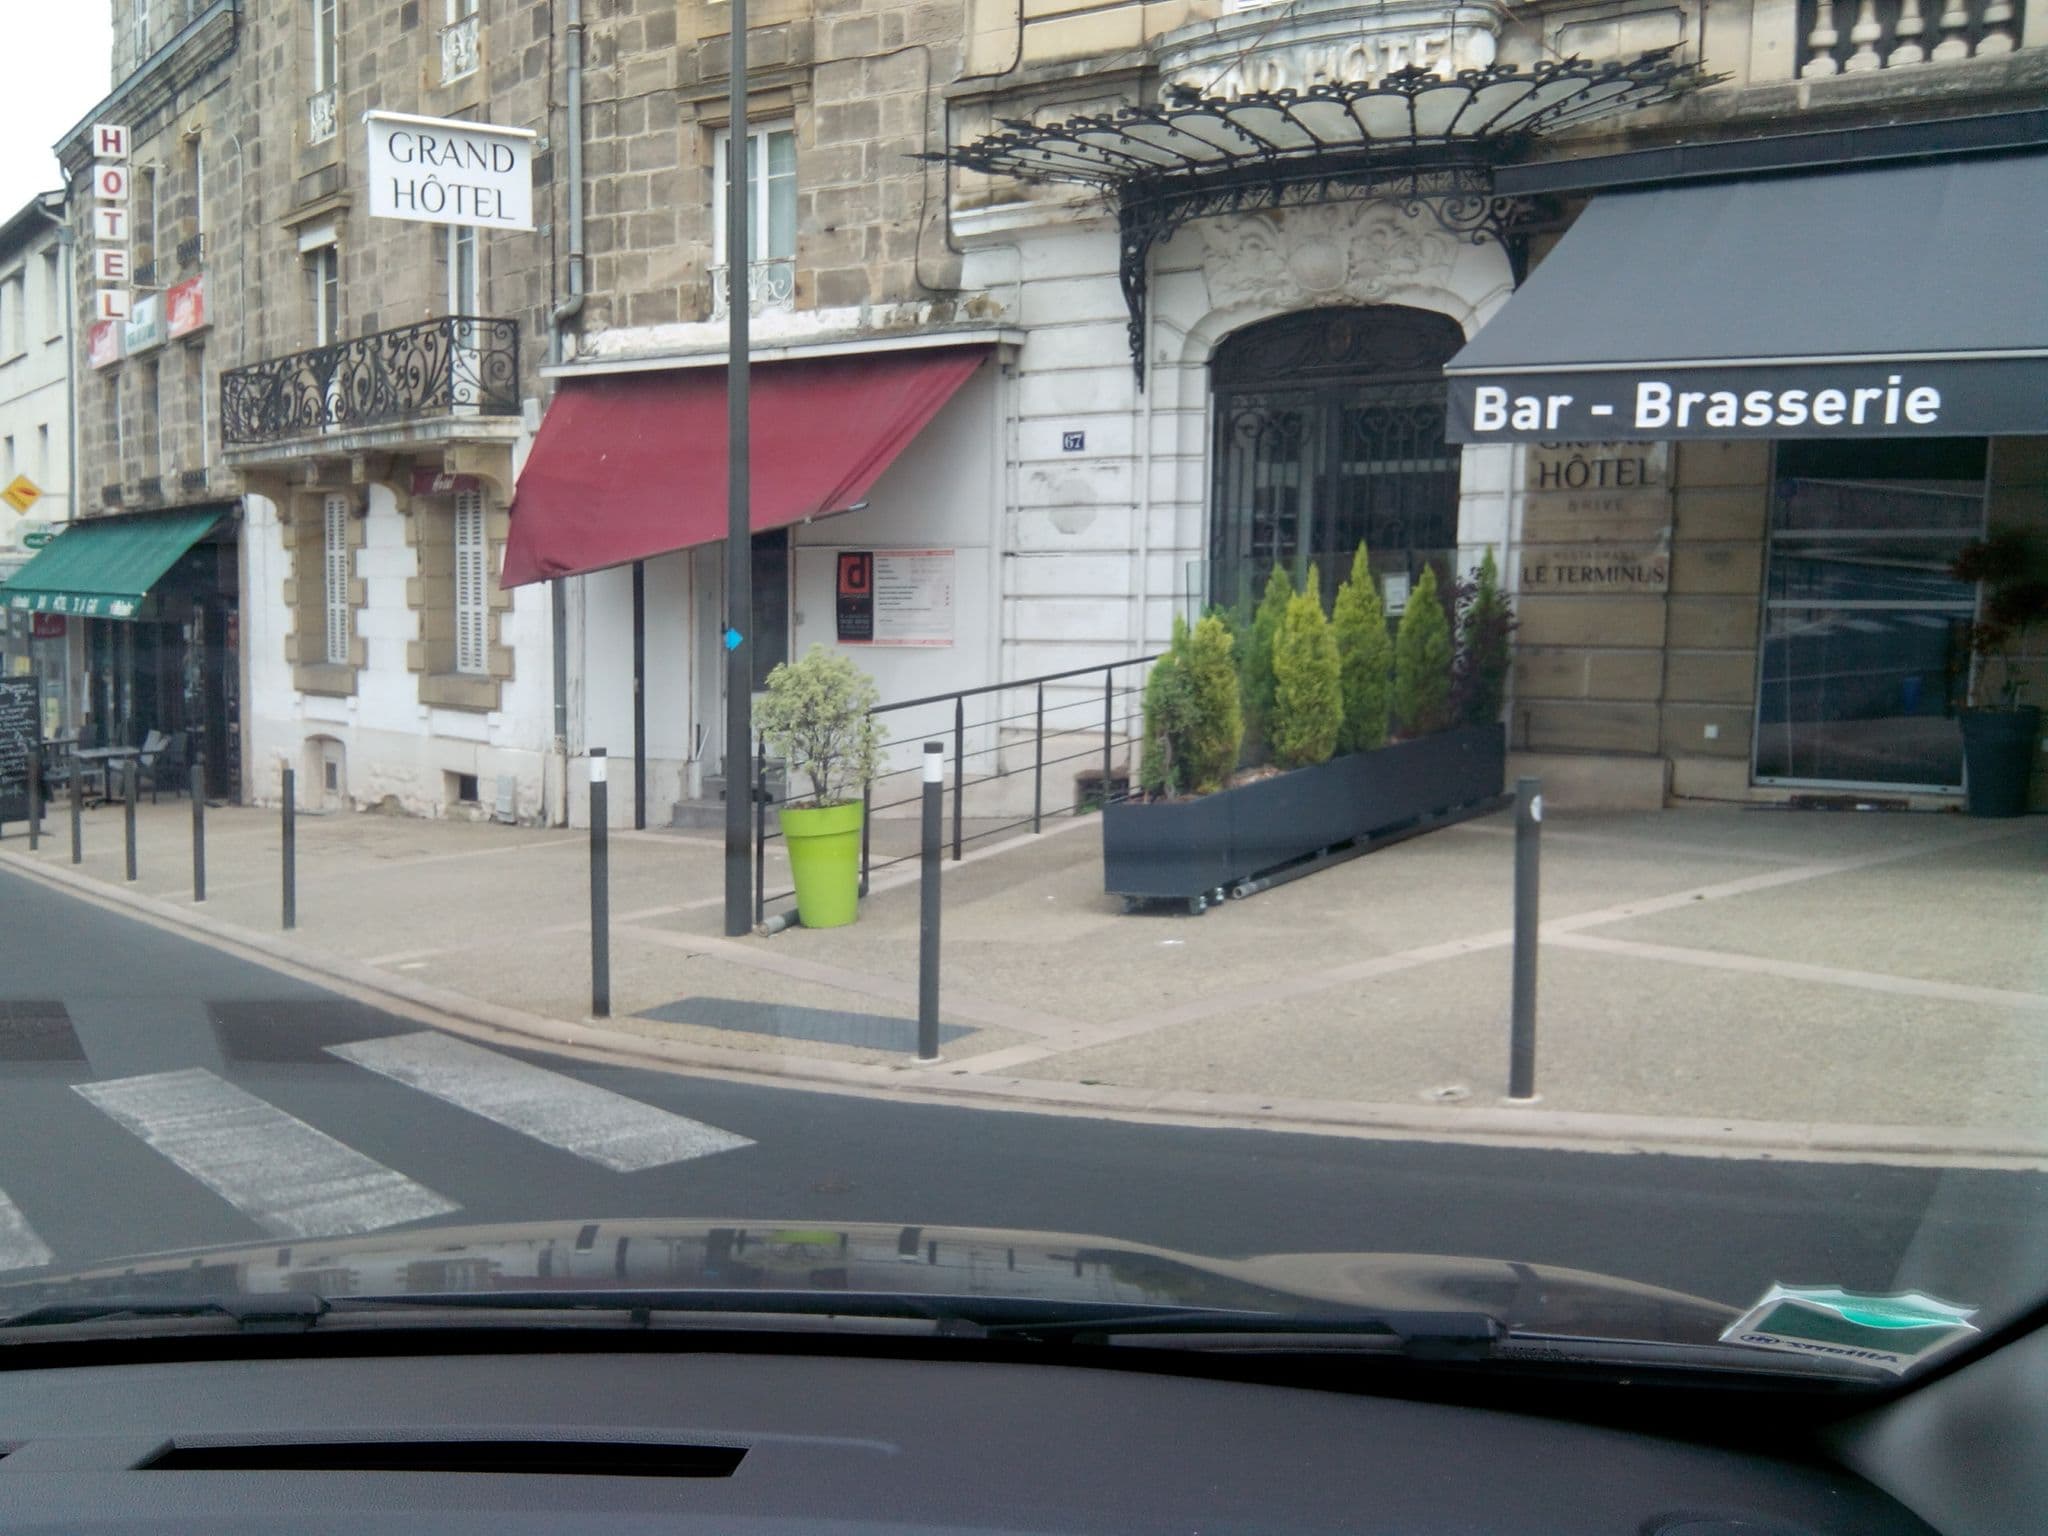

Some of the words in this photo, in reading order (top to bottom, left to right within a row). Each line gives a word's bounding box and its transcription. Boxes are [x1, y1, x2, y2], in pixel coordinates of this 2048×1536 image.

[388, 131, 515, 174] GRAND
[392, 173, 516, 221] HÔTEL
[102, 129, 124, 317] HOTEL
[1473, 386, 1574, 431] Bar
[1635, 375, 1942, 429] Brasserie
[1064, 433, 1083, 449] 67
[1538, 453, 1657, 488] HÔTEL
[1523, 565, 1547, 585] LE
[1554, 565, 1665, 584] TERMINUS
